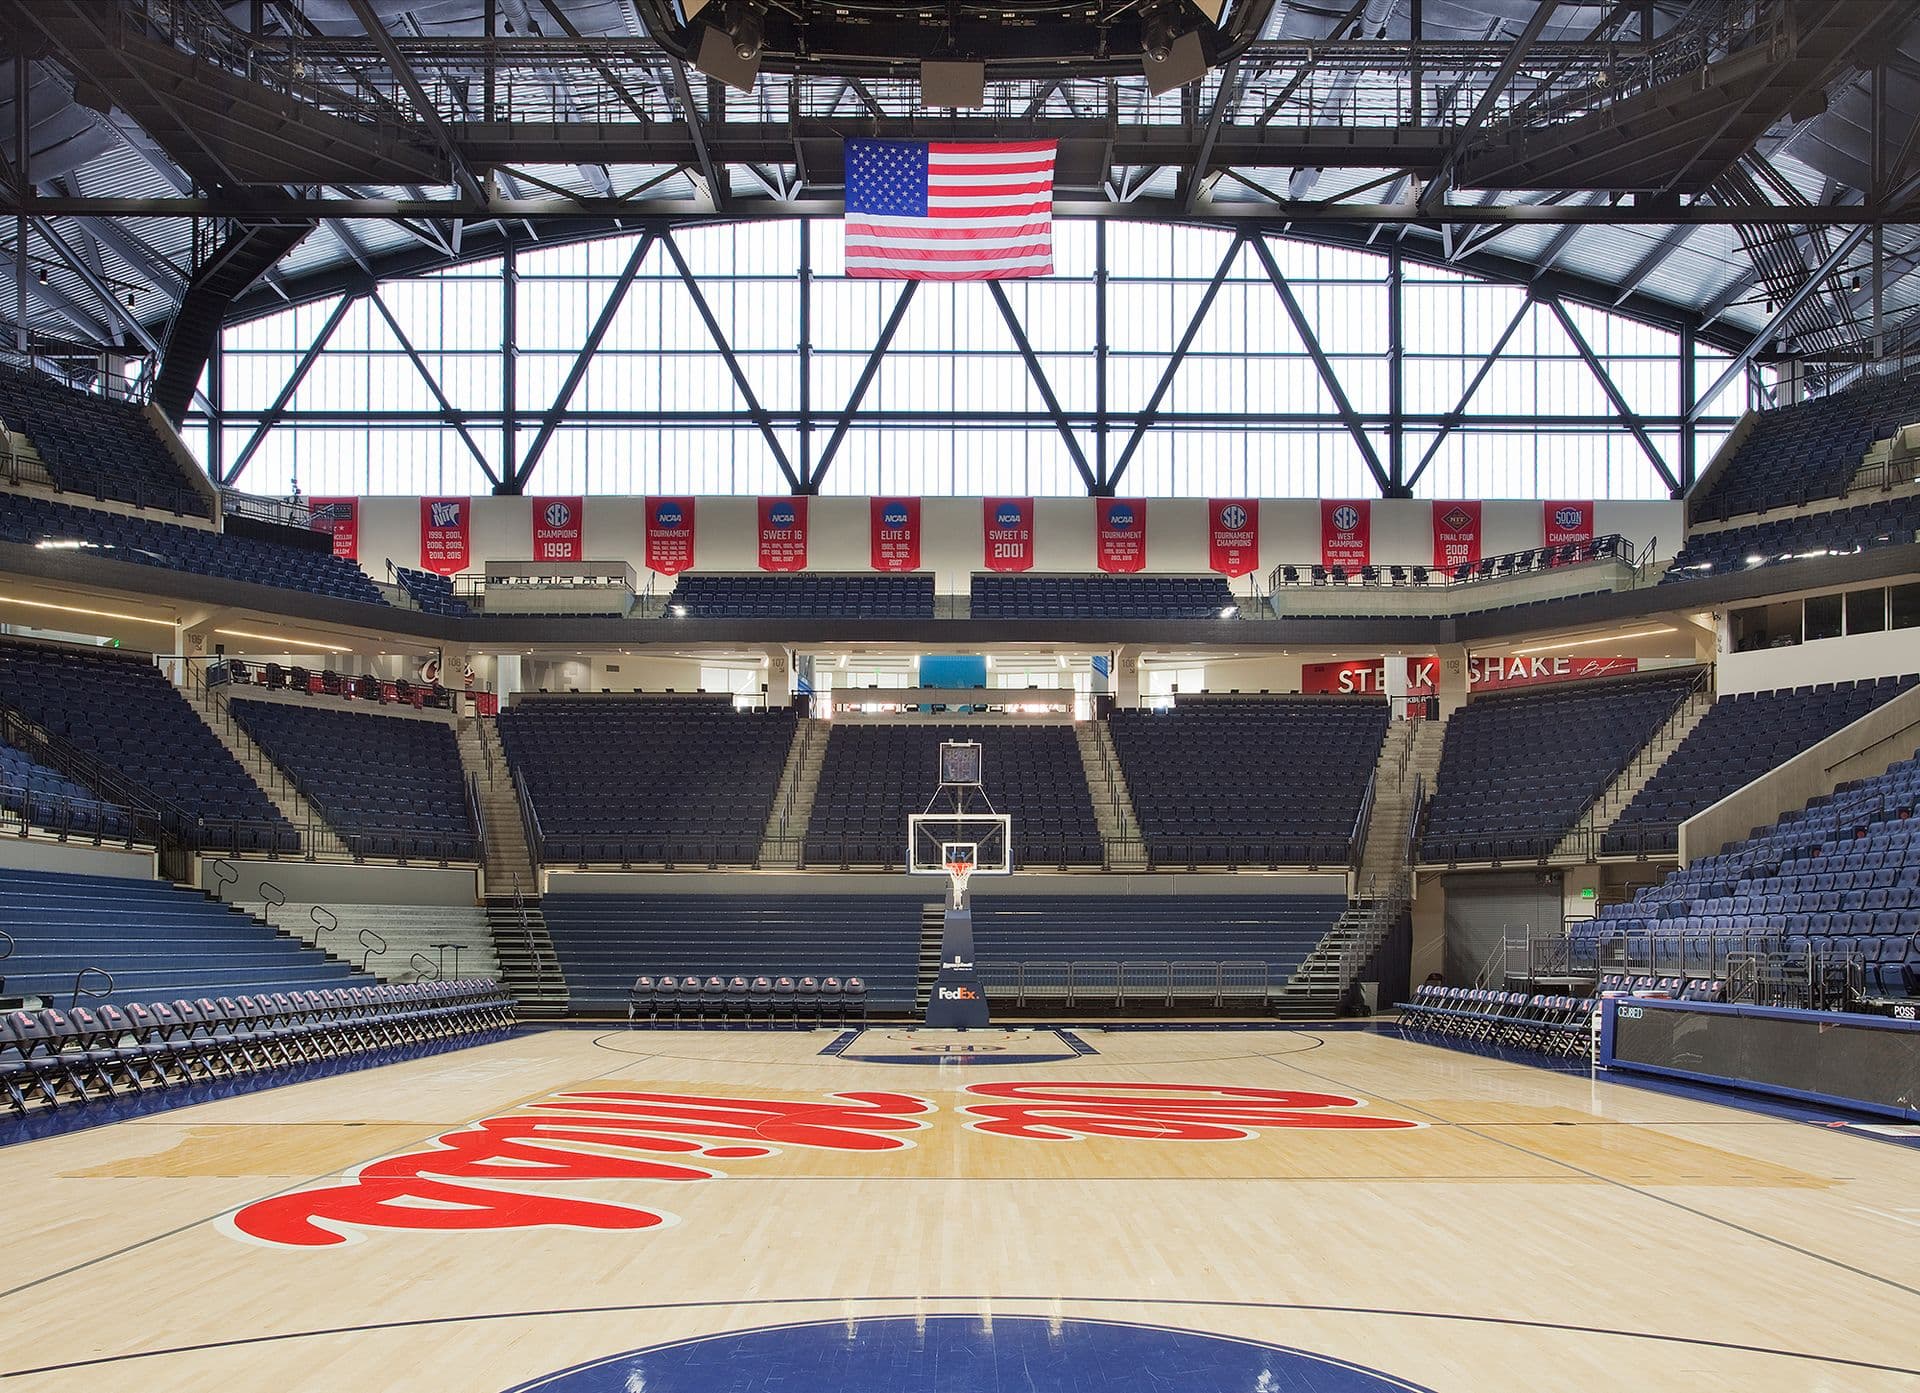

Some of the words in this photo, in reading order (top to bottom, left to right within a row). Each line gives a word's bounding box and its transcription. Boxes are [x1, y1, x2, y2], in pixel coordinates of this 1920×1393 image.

[547, 504, 569, 526] SEC
[659, 514, 682, 522] NCAA
[772, 514, 795, 522] NCAA
[884, 514, 907, 522] NCAA
[998, 515, 1021, 523] NCAA
[1222, 506, 1246, 529] SEC
[1334, 507, 1357, 529] SEC
[1556, 510, 1582, 525] SOCON
[537, 529, 578, 539] CHAMPIONS
[763, 530, 792, 540] SWEET
[795, 530, 803, 540] 16
[881, 531, 903, 540] ELITE
[905, 531, 910, 540] 8
[989, 531, 1018, 540] SWEET
[1021, 531, 1029, 540] 16
[1102, 531, 1142, 539] TOURNAMENT
[1440, 533, 1457, 541] FINAL
[1459, 533, 1474, 541] FOUR
[1549, 533, 1590, 542] CHAMPIONS
[1216, 539, 1252, 547] CHAMPIONS
[1328, 540, 1363, 548] CHAMPIONS
[543, 543, 572, 558] 1992
[994, 543, 1024, 558] 2001
[1445, 545, 1469, 555] 2008
[772, 658, 785, 667] 107
[1446, 659, 1459, 669] 109
[1470, 657, 1571, 684] SHAKE
[1338, 663, 1433, 694] STEK
[938, 987, 977, 1000] FedEx
[1894, 1006, 1915, 1017] POSS
